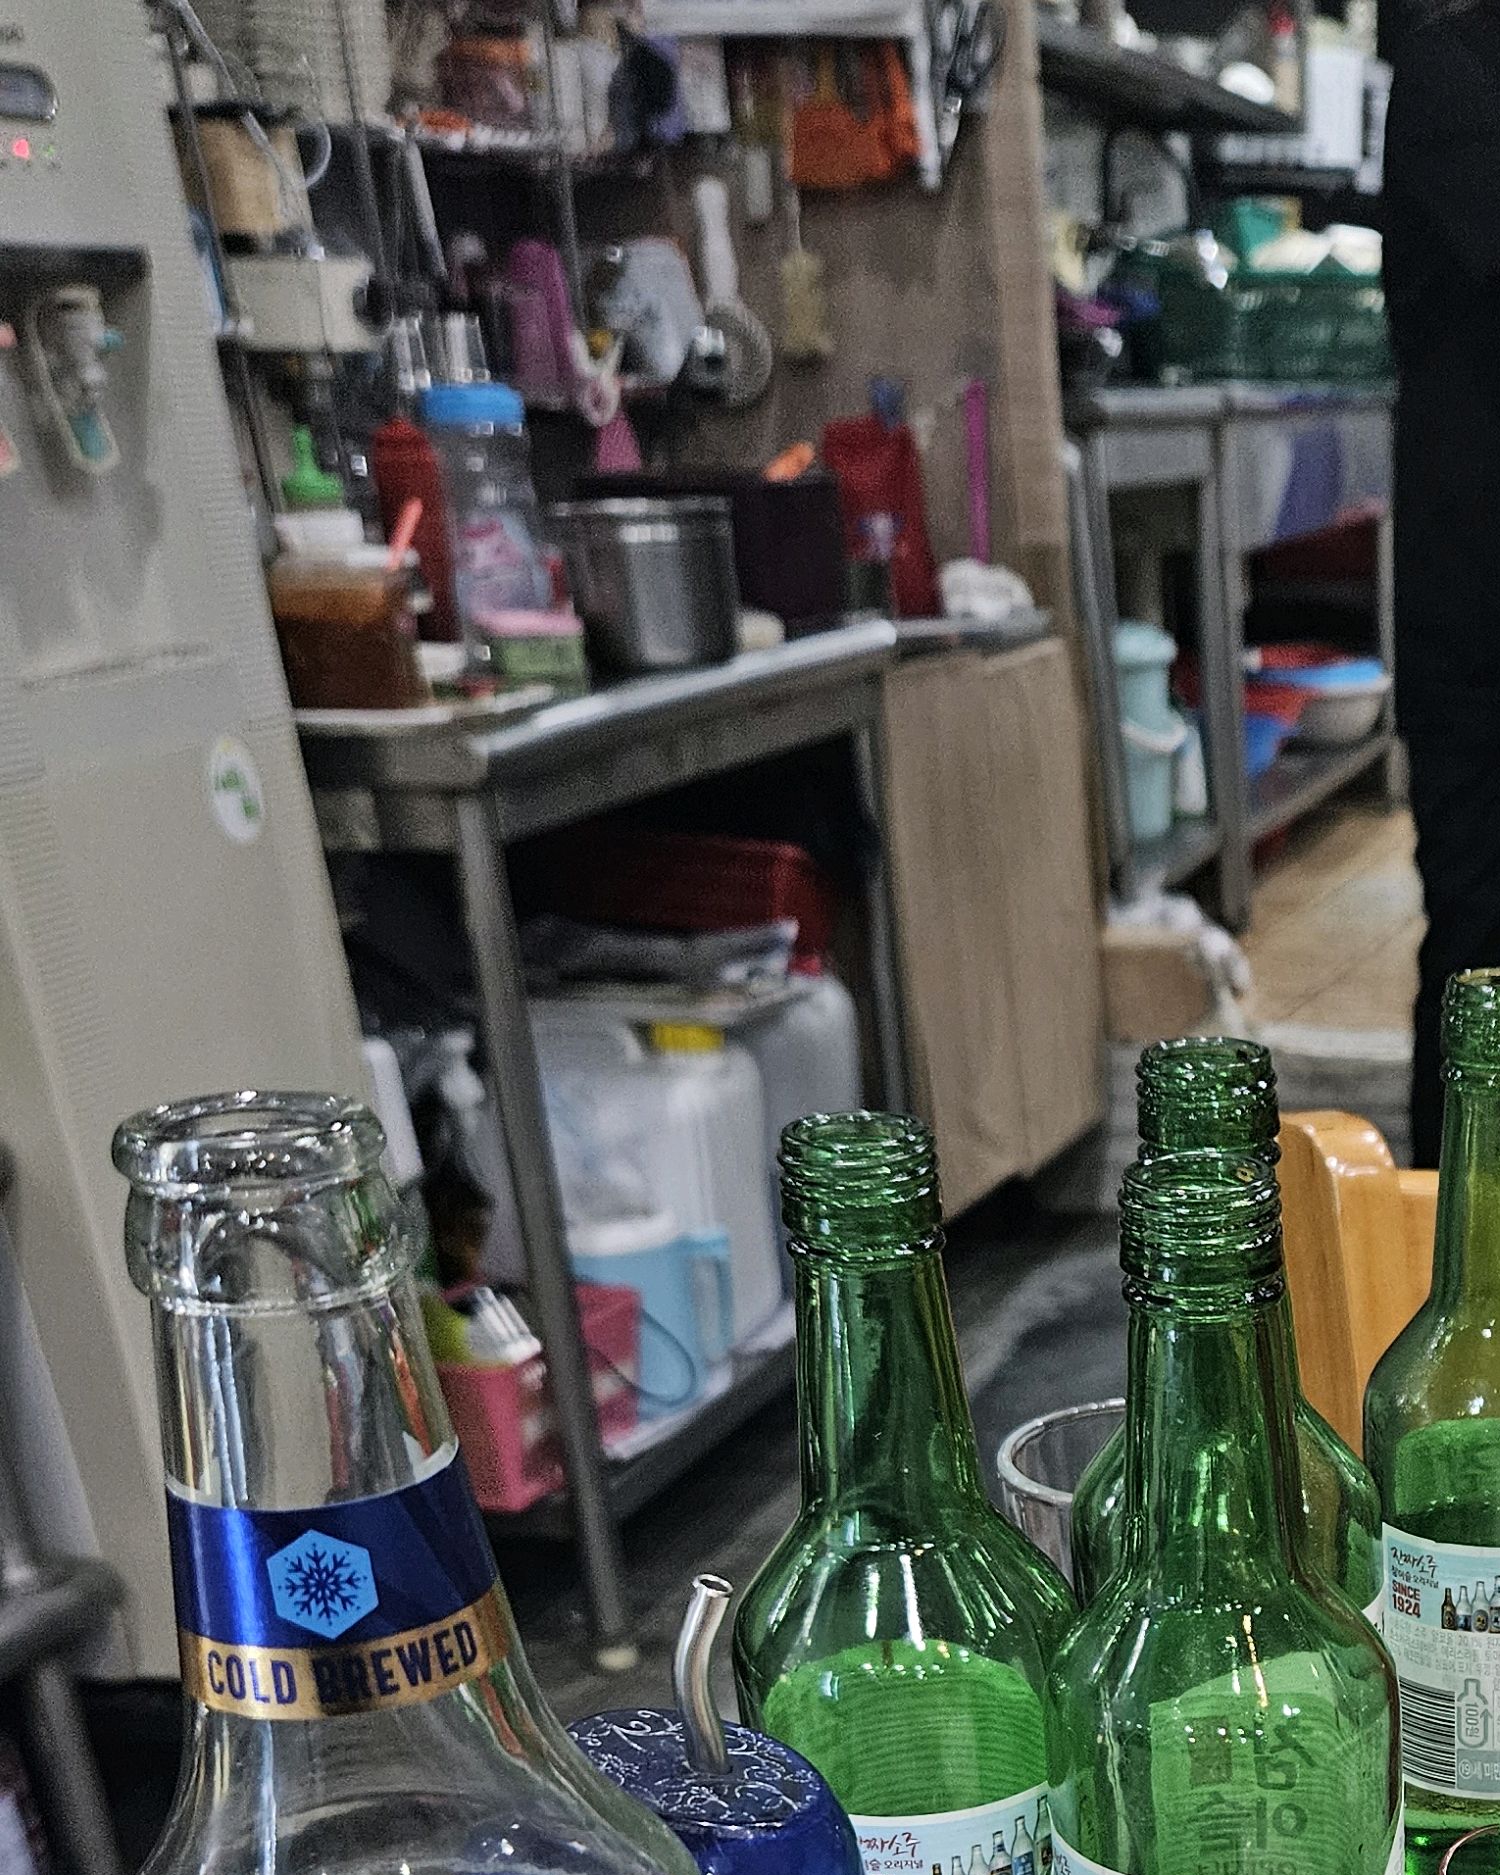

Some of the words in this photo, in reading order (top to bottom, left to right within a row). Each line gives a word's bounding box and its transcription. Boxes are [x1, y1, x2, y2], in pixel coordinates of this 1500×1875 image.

[1391, 1579, 1421, 1602] SINCE
[1391, 1593, 1422, 1619] 1924
[206, 1648, 298, 1706] COLD
[313, 1619, 480, 1703] BREWED
